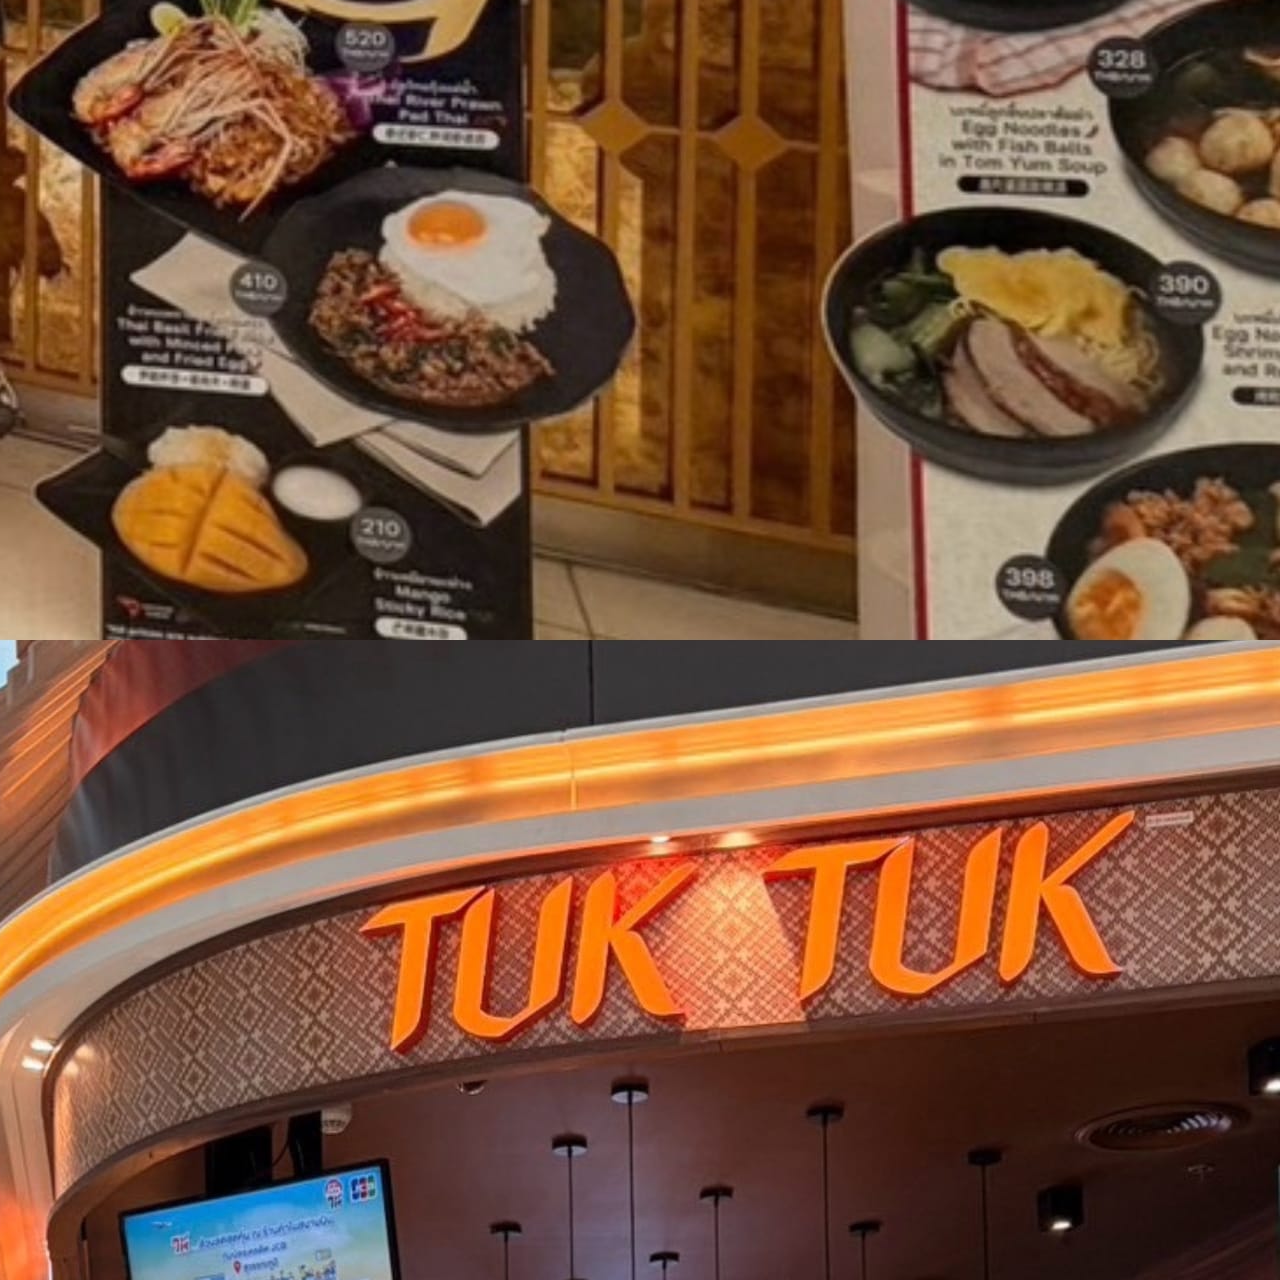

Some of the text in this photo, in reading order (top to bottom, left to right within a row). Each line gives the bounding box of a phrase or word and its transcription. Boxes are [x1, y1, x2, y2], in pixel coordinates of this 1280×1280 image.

[344, 30, 387, 48] 520
[1097, 48, 1146, 69] 328
[239, 273, 278, 292] 410
[1159, 275, 1209, 295] 390
[361, 519, 401, 538] 210
[1005, 567, 1055, 590] 398
[360, 809, 1135, 1053] TUK TUK
